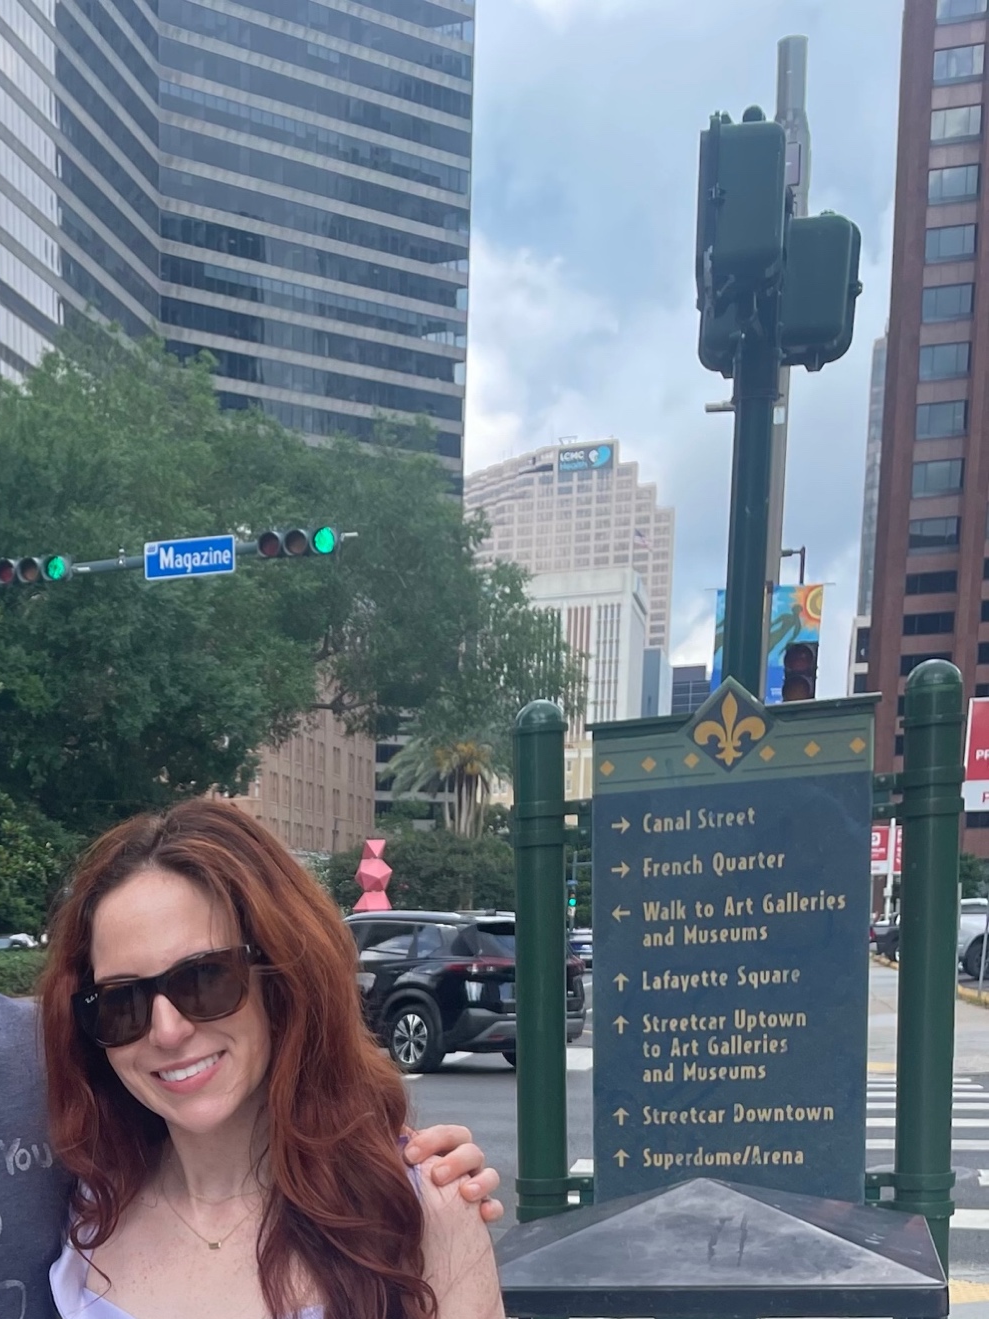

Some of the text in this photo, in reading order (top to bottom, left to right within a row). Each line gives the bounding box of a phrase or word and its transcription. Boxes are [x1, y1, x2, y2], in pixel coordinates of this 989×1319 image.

[159, 546, 232, 574] Magazine
[643, 807, 756, 834] Canal Street
[643, 852, 786, 878] French Quarter
[643, 890, 846, 922] Walk to Art Galleries
[643, 924, 768, 947] and Museums
[642, 965, 801, 993] Lafayette Square
[643, 1009, 807, 1033] Streetcar Uptown
[643, 1033, 788, 1058] to Art Galleries
[643, 1061, 766, 1083] and Museums
[643, 1103, 835, 1126] Streetcar Downtown
[643, 1145, 805, 1171] Superdome/Arena
